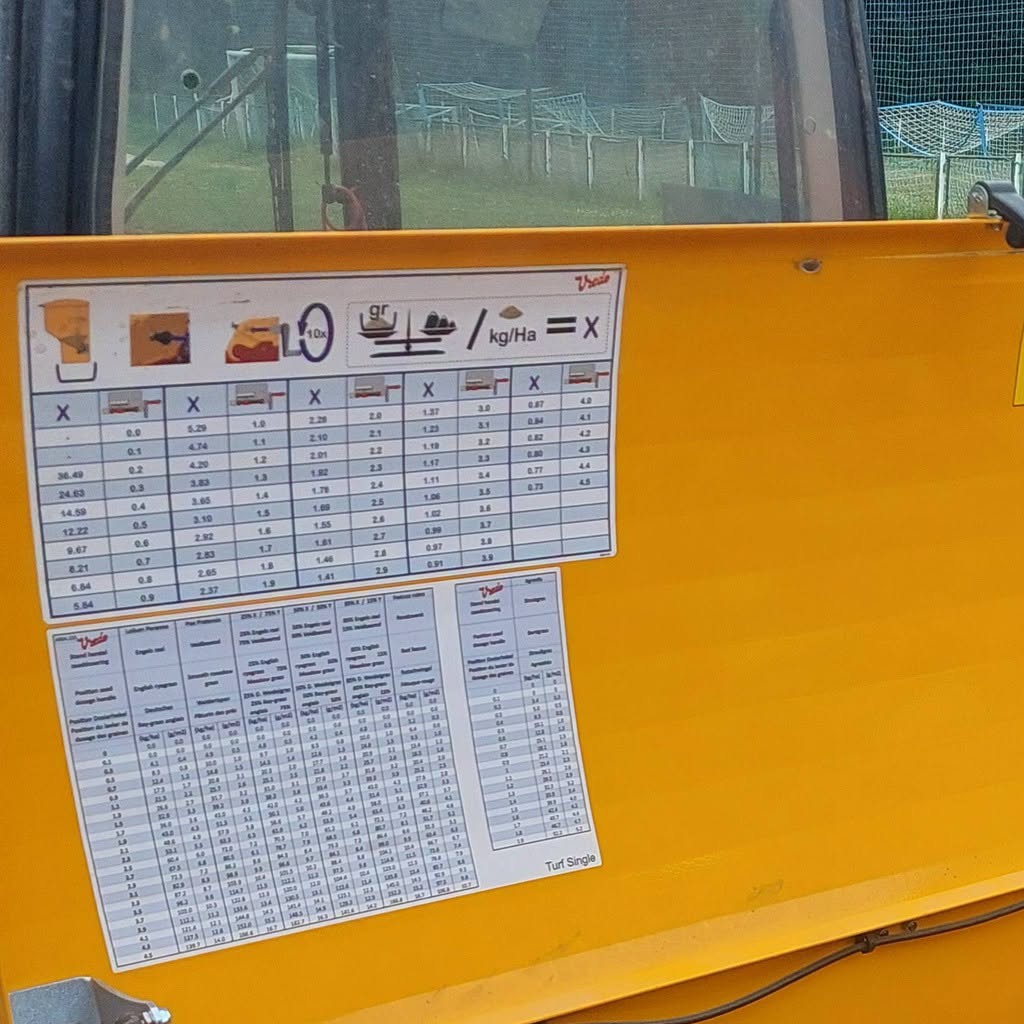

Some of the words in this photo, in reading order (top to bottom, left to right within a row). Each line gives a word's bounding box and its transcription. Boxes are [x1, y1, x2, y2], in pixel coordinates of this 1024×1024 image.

[369, 303, 389, 320] gr
[489, 327, 537, 346] kg/Ha
[583, 316, 599, 339] X
[306, 329, 327, 340] 10x
[56, 404, 70, 421] X
[187, 396, 200, 413] X
[309, 389, 321, 405] X
[423, 382, 435, 398] X
[529, 375, 540, 391] X
[126, 428, 141, 438] 0.0
[252, 419, 266, 429] 1.0
[369, 411, 382, 421] 2.0
[127, 447, 142, 457] 0.1
[253, 437, 267, 447] 1.1
[369, 428, 382, 439] 2.1
[478, 420, 490, 430] 3.1
[579, 412, 591, 422] 4.1
[129, 465, 143, 475] 0.2
[254, 454, 267, 465] 1.2
[478, 437, 490, 447] 3.2
[579, 428, 591, 438] 4.2
[130, 483, 144, 493] 0.3
[254, 472, 268, 483] 1.3
[370, 463, 383, 473] 2.3
[131, 502, 146, 512] 0.4
[255, 490, 269, 500] 1.4
[370, 480, 383, 490] 2.4
[478, 470, 490, 480] 3.4
[579, 461, 590, 471] 4.4
[132, 520, 147, 530] 0.5
[257, 508, 270, 518] 1.5
[371, 497, 384, 507] 2.5
[579, 477, 591, 487] 4.5
[134, 539, 149, 549] 0.6
[258, 526, 271, 536] 1.6
[372, 514, 385, 524] 2.6
[136, 557, 151, 567] 0.7
[259, 544, 272, 554] 1.7
[373, 531, 386, 541] 2.7
[479, 520, 492, 530] 3.7
[140, 593, 155, 603] 0.9
[262, 579, 276, 589] 1.9
[375, 565, 388, 575] 2.9
[481, 553, 494, 563] 3.9
[545, 858, 565, 872] Turf
[566, 853, 596, 867] Single
